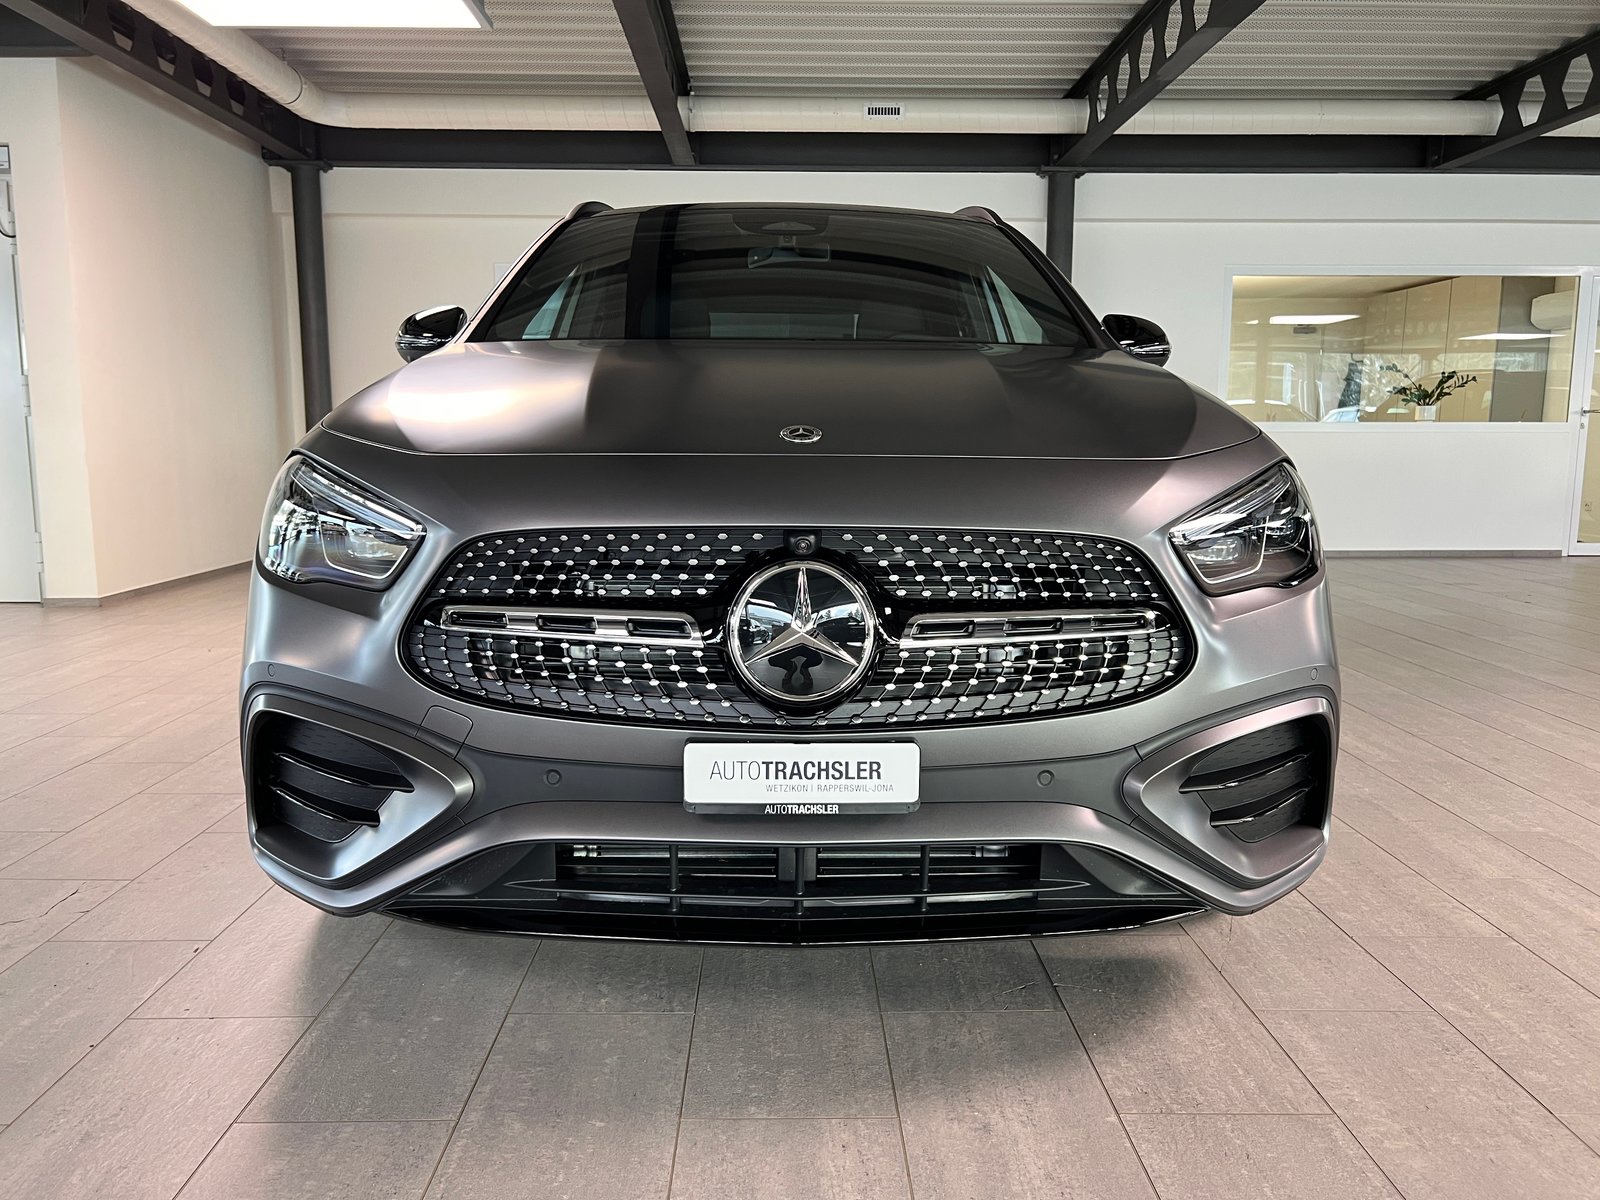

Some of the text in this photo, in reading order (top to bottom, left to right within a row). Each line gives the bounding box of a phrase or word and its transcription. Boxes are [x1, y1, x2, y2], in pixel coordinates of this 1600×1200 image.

[709, 760, 882, 780] AUTOTRACHSLER
[766, 784, 894, 793] WETZIKON RAPPERSWIL-JONA
[765, 805, 839, 815] AUTOTRACHSLER
